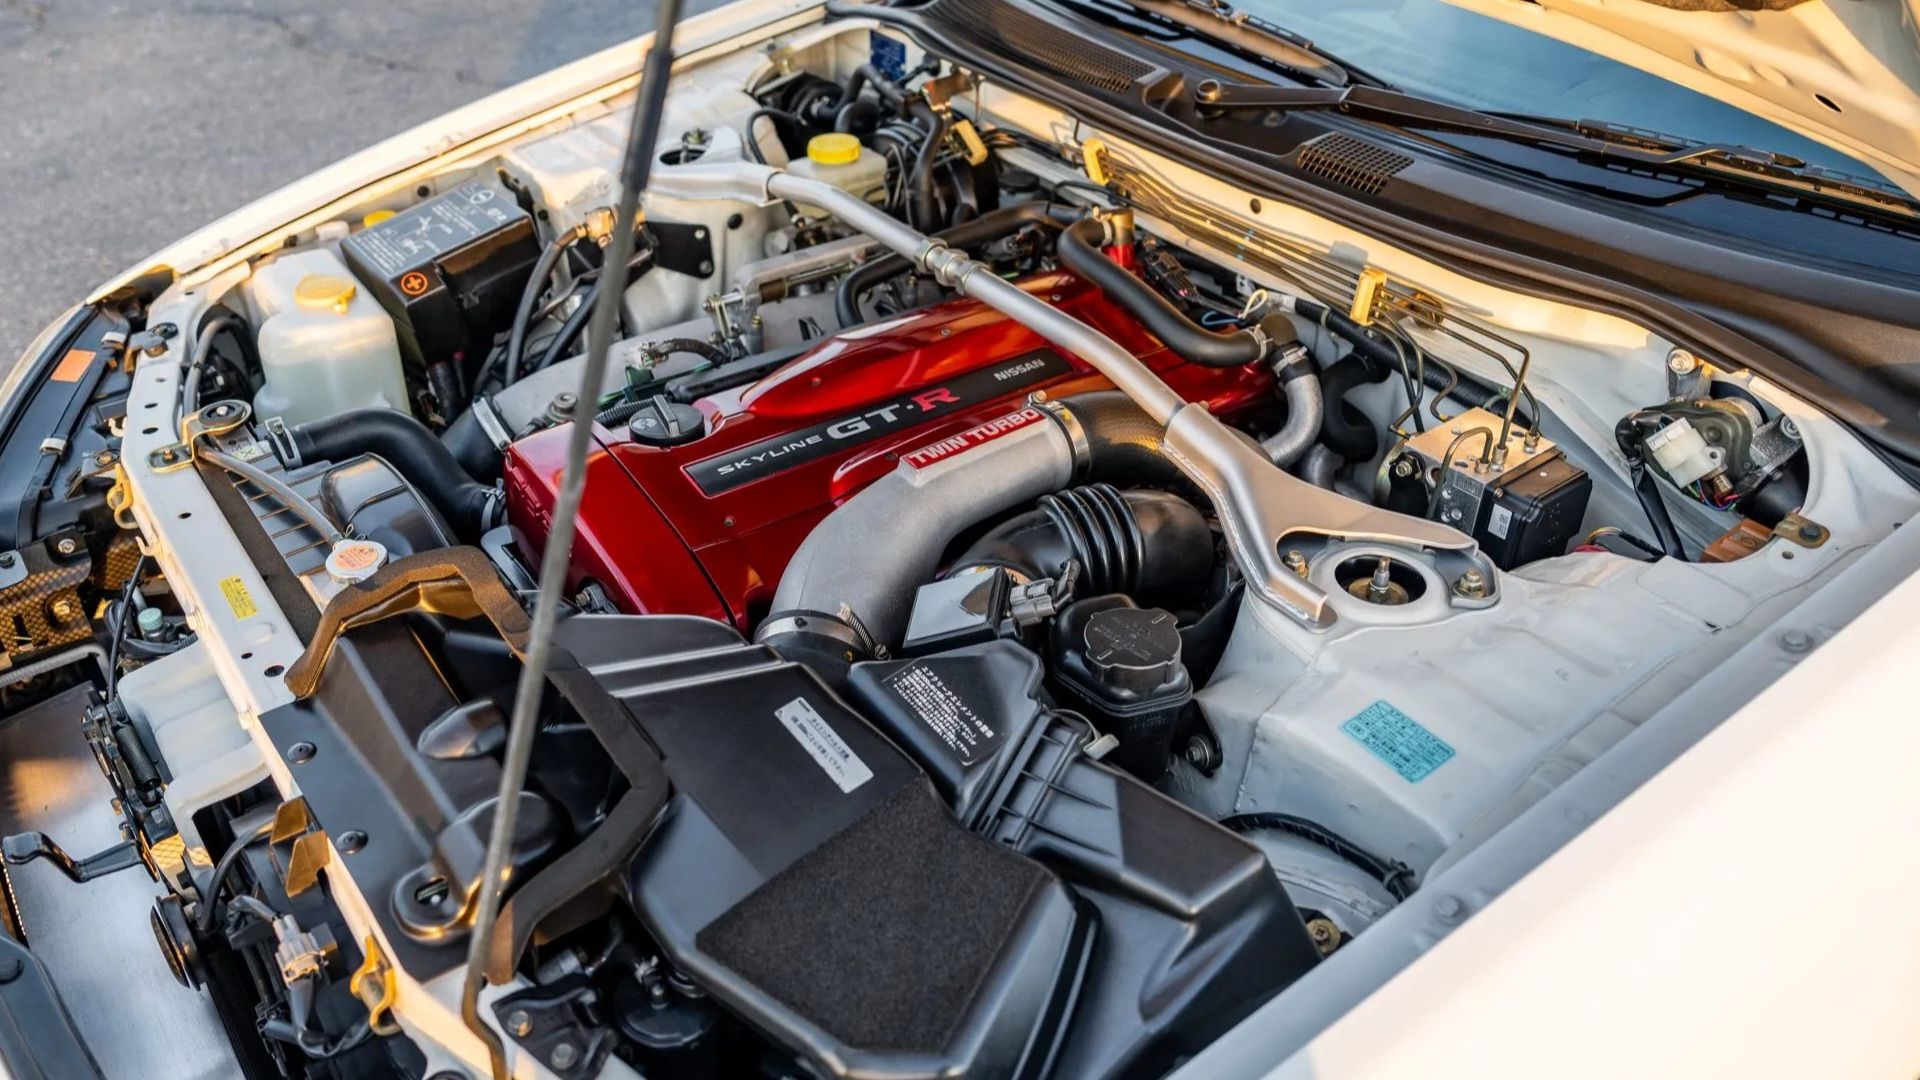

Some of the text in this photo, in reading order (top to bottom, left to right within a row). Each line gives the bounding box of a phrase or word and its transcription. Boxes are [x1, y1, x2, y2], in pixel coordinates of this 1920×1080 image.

[718, 434, 823, 475] SKYLINE
[994, 358, 1045, 381] NISSAN
[908, 408, 1041, 464] TWIN TURBO
